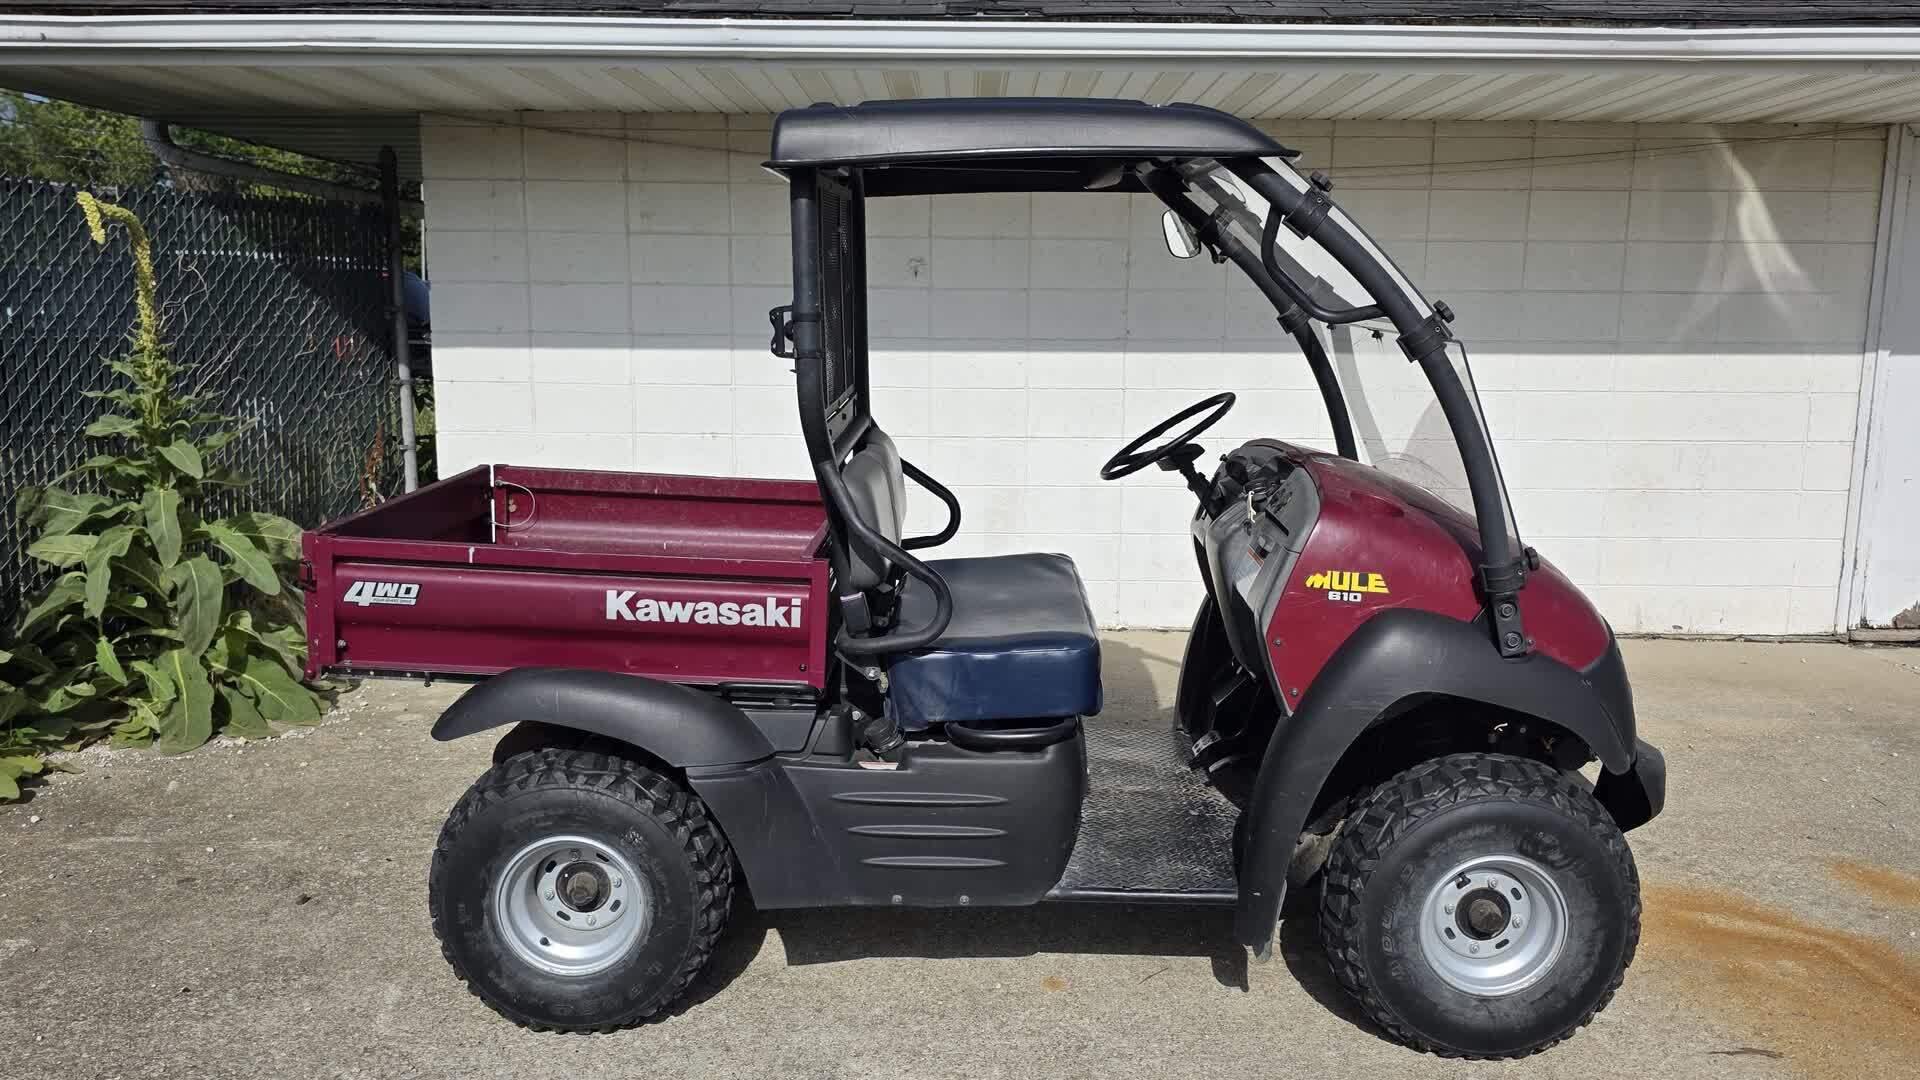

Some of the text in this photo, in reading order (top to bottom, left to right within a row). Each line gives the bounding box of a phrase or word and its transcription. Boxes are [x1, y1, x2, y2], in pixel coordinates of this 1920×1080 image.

[343, 581, 420, 607] 4WD
[1305, 570, 1391, 594] MULE
[606, 589, 801, 628] Kawasaki
[1327, 590, 1362, 602] 610
